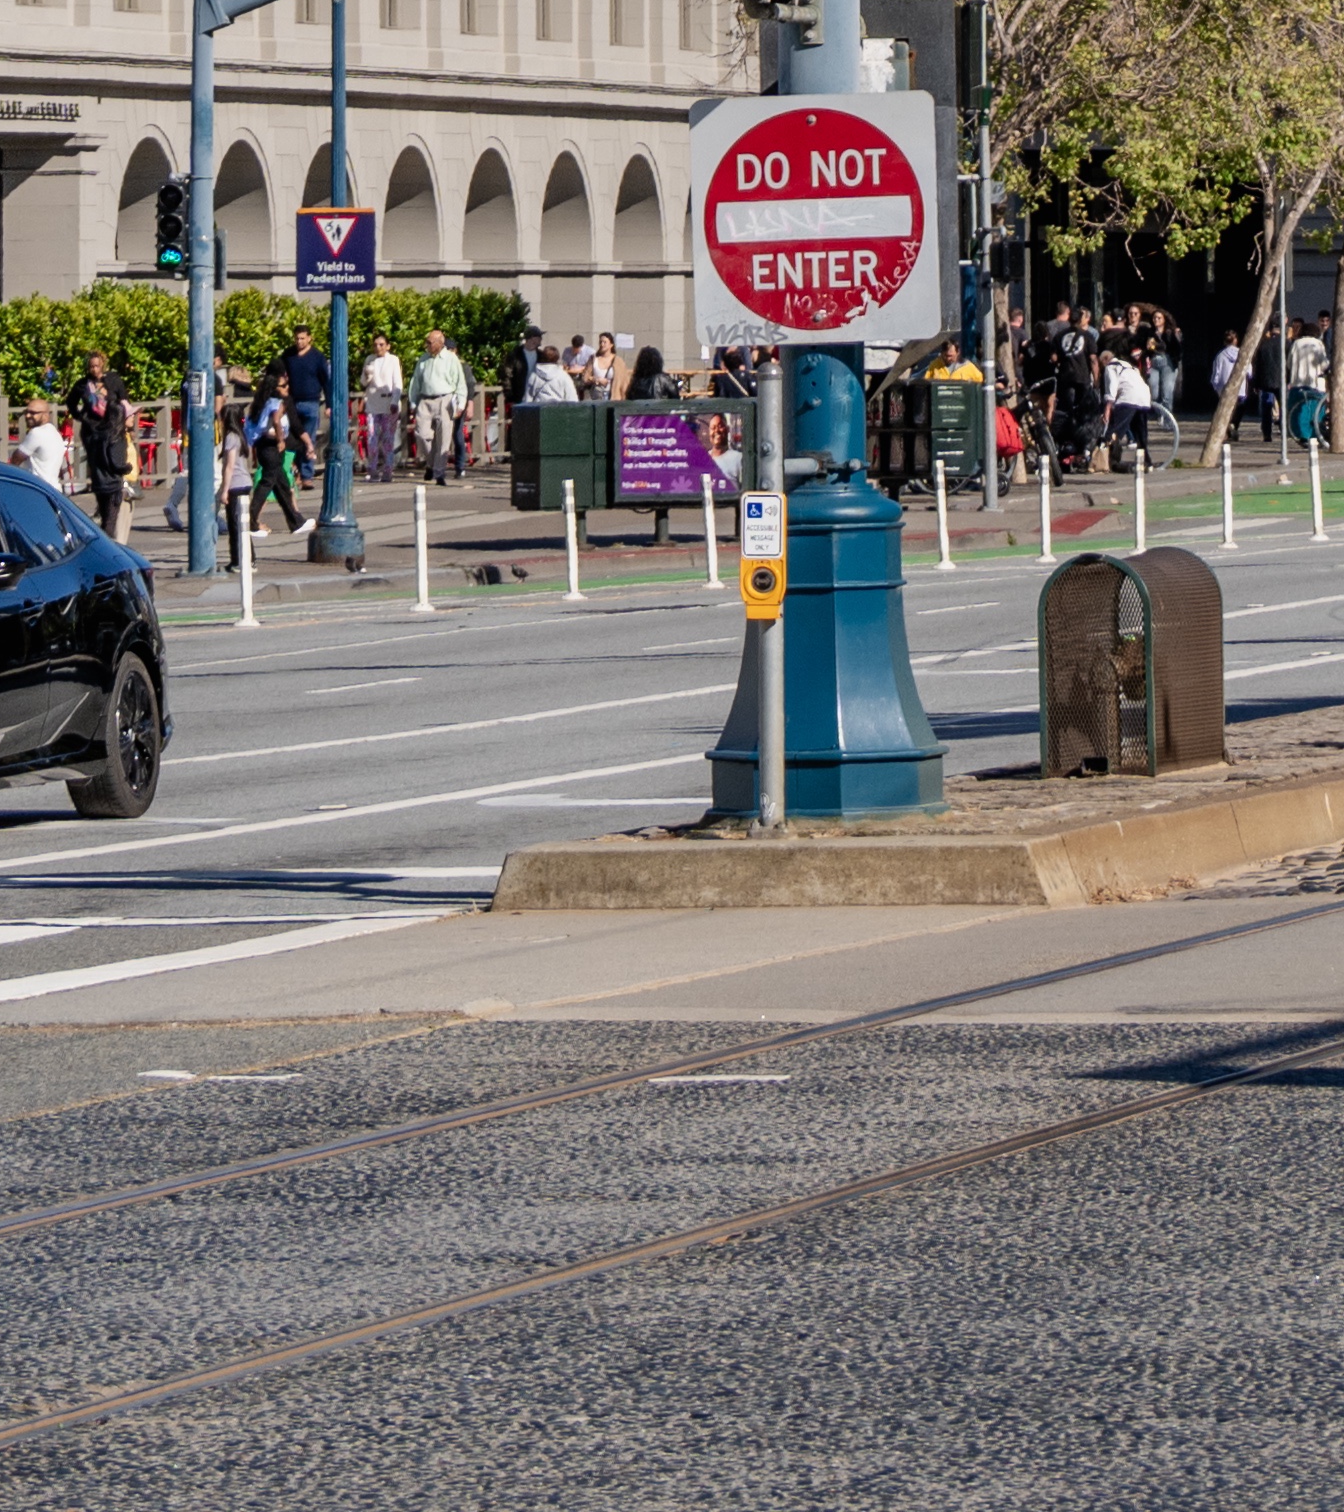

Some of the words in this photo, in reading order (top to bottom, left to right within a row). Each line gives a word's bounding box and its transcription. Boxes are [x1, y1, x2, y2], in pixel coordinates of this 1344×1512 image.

[737, 152, 790, 191] DO
[811, 148, 887, 188] NOT
[306, 273, 365, 284] Pedestrians
[317, 261, 342, 272] Yield
[344, 262, 355, 272] to
[752, 250, 879, 291] ENTER
